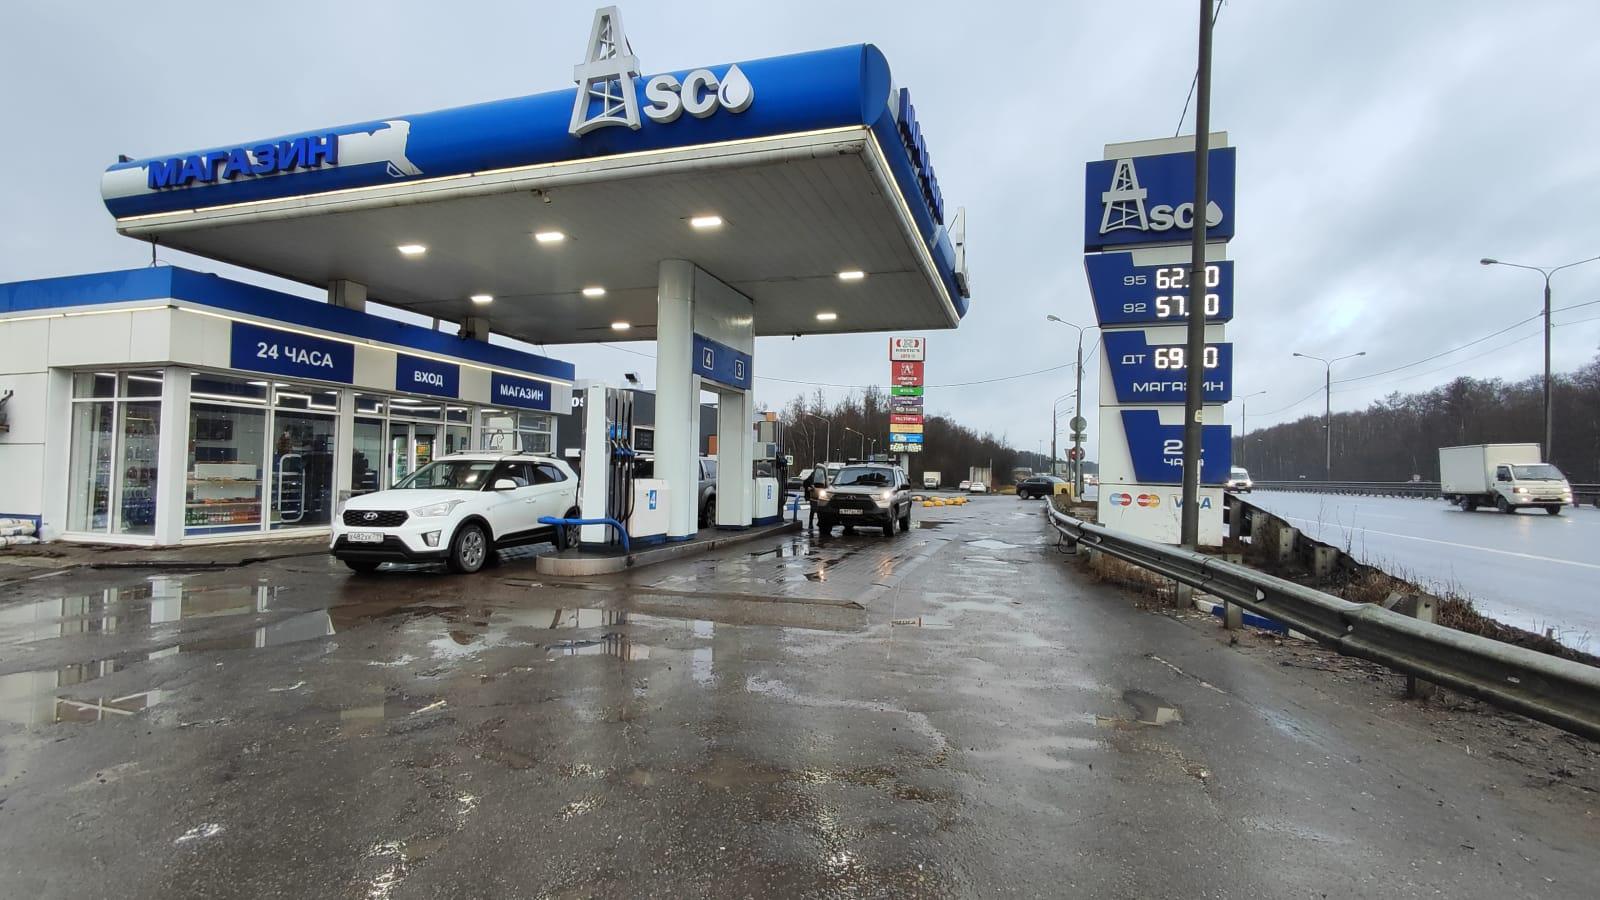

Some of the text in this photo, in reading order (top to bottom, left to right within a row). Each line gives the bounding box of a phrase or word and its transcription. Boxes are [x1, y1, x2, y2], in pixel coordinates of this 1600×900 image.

[148, 133, 339, 190] МАГАЗИН
[1123, 265, 1219, 289] 95 62.0
[1123, 294, 1219, 317] 92 57.0
[256, 342, 334, 369] 24 ЧАСА
[705, 352, 711, 366] 4
[1121, 347, 1219, 369] ДТ 69.0
[414, 370, 444, 387] ВХОД
[737, 363, 742, 377] 3
[500, 383, 544, 401] МАГАЗИН
[1133, 381, 1224, 392] МАГАИН
[1173, 497, 1212, 509] VA
